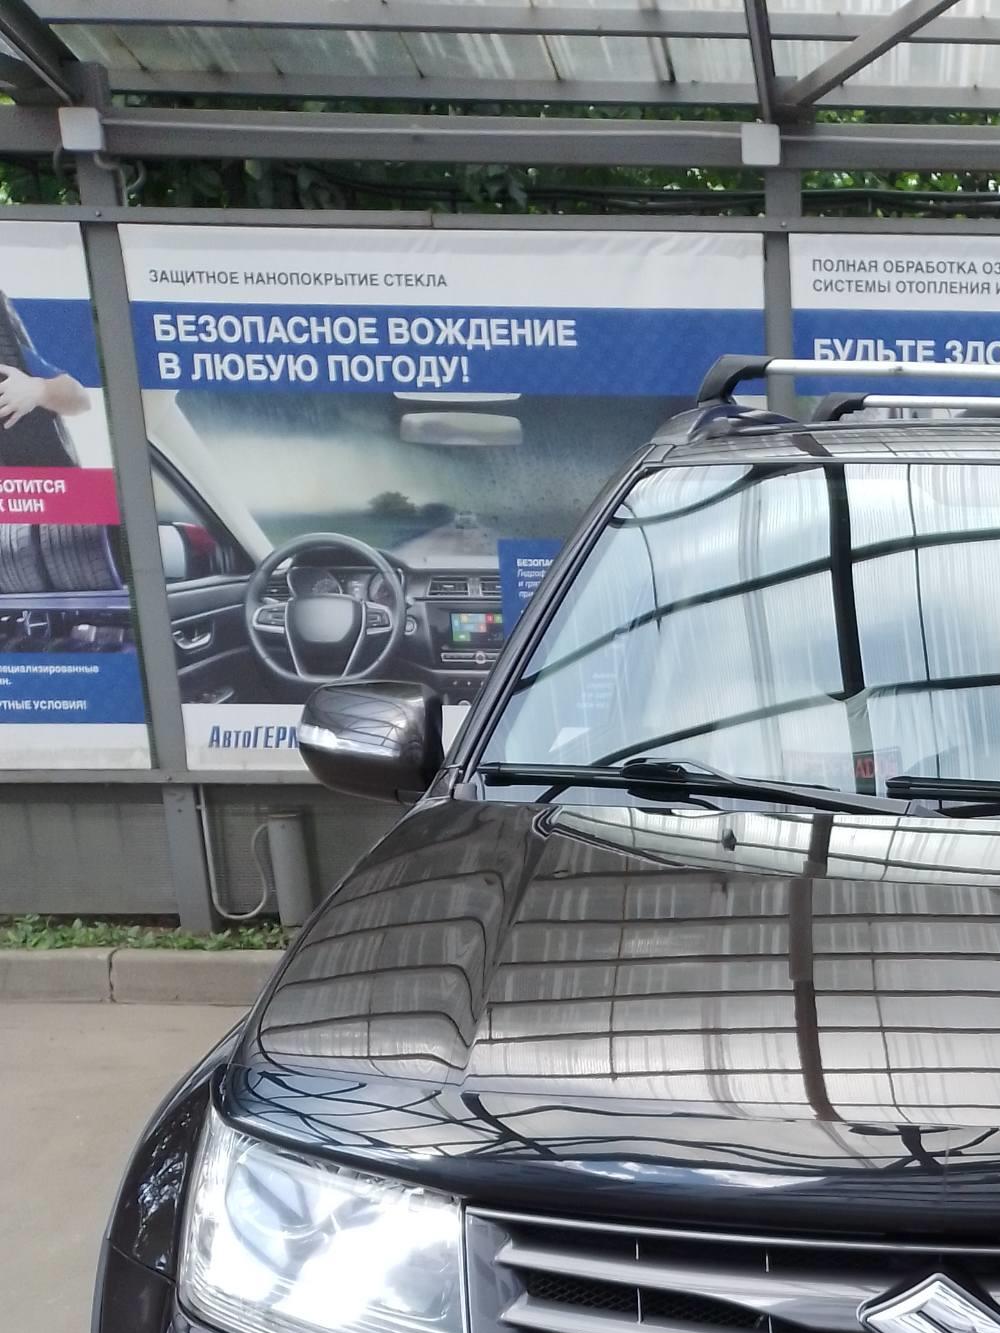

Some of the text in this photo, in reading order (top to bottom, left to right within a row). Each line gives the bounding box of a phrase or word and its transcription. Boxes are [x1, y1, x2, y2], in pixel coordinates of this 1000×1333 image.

[812, 258, 878, 274] ПОЛНАЯ
[883, 259, 978, 275] ОБРАБОТКА
[149, 269, 447, 288] ЗАЩИТНОЕ НАНОПОКРЫТИЕ СТЕКЛА
[812, 278, 891, 294] СИСТЕМЫ
[895, 279, 991, 295] ОТОПЛЕНИЯ
[153, 313, 577, 350] БЕЗОПАСНОЕ ВОЖДЕНИЕ
[158, 353, 470, 388] В ЛЮБУЮ ПОГОДУ!
[8, 498, 44, 513] ШИН
